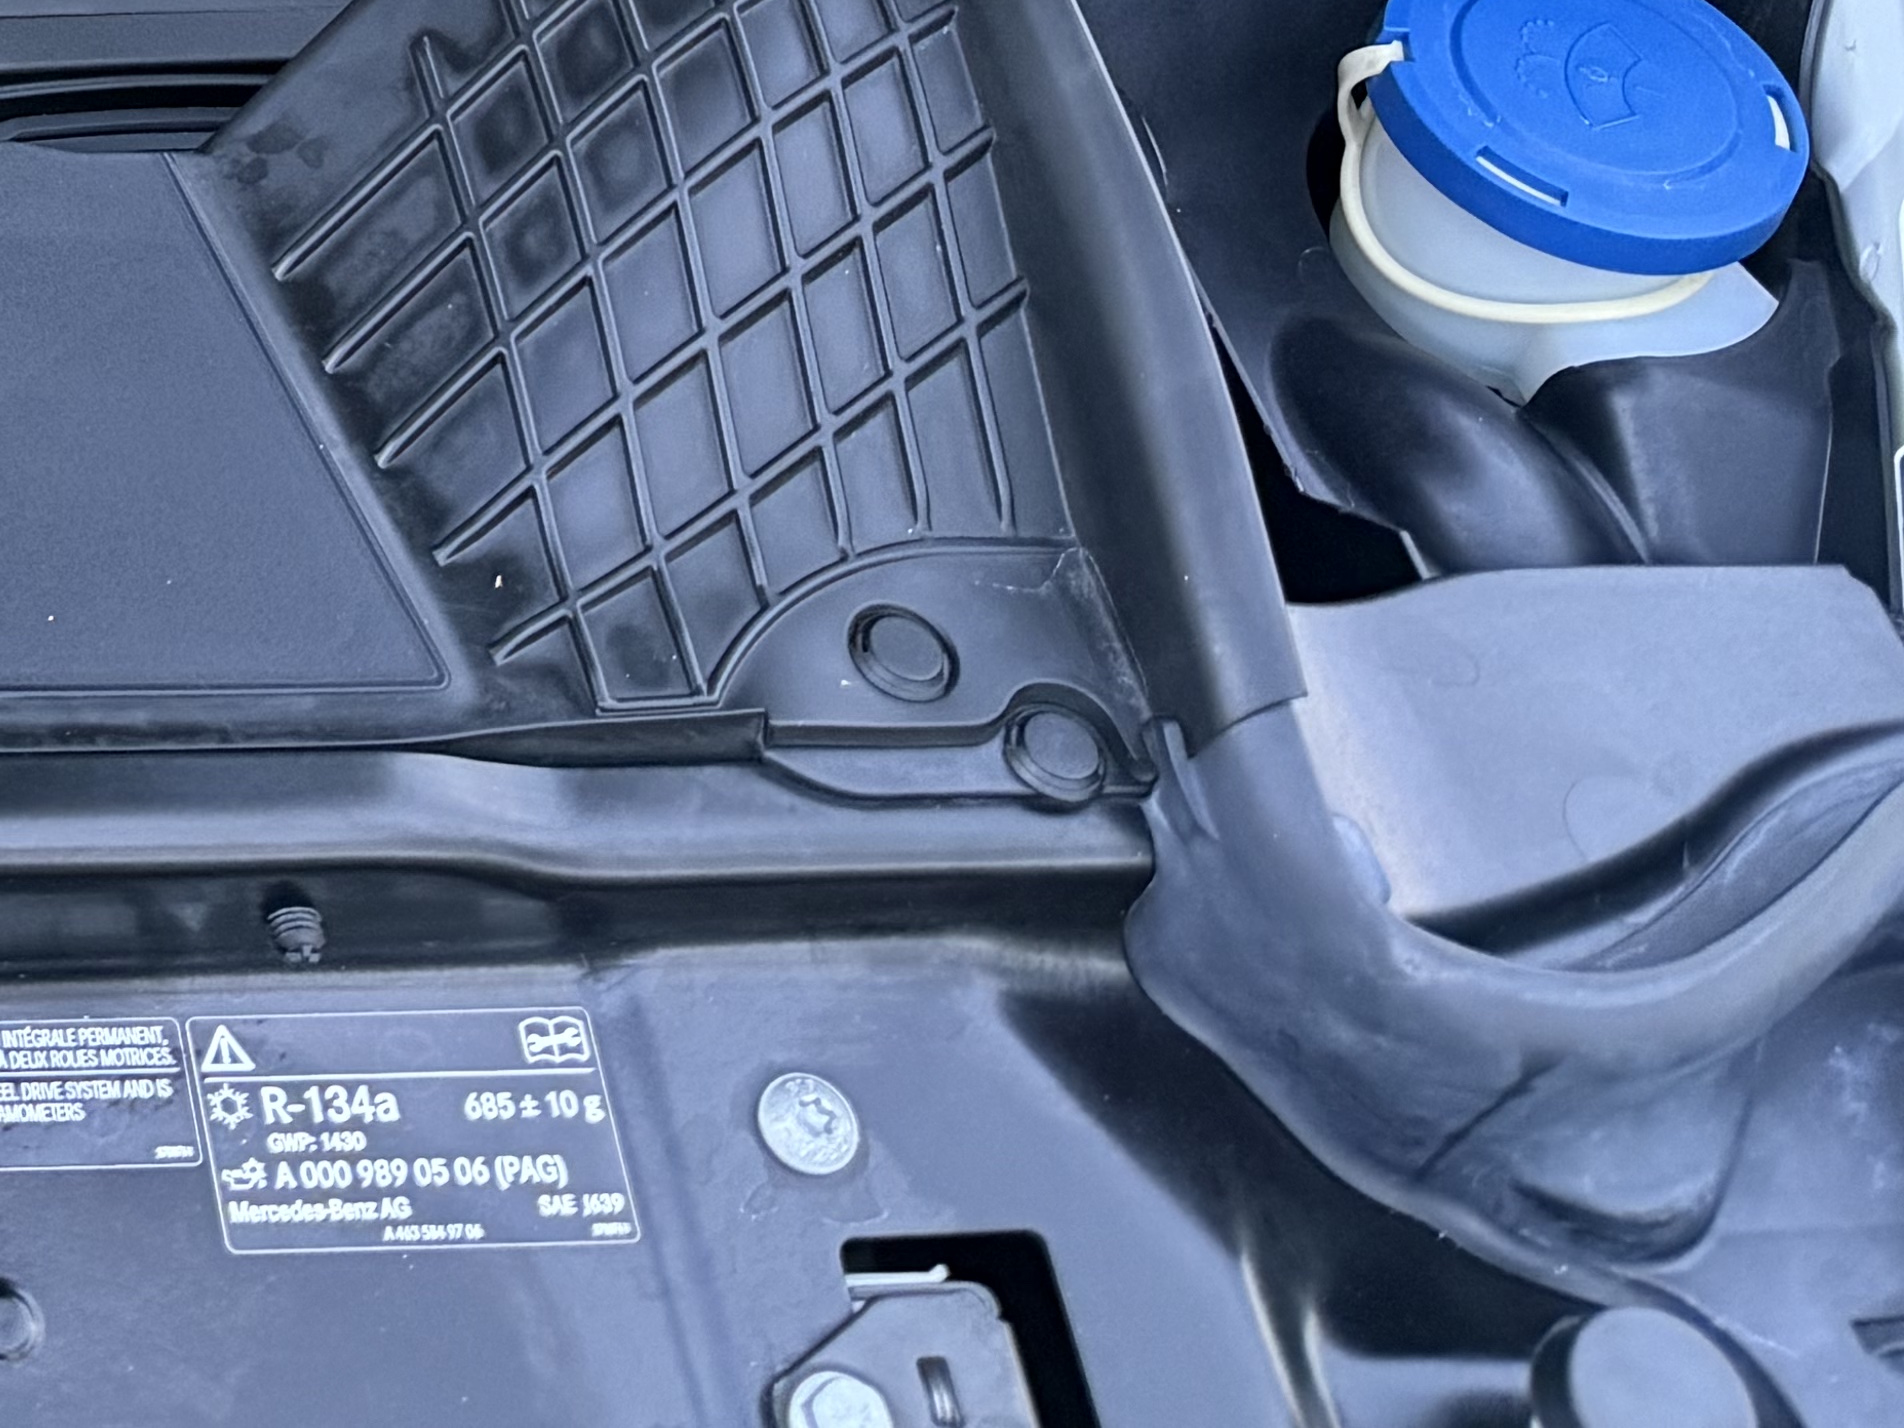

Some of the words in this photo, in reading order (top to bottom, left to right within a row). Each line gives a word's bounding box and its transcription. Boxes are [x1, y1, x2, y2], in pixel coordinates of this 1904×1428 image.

[3, 1025, 76, 1047] INTÉGRALE
[9, 1050, 49, 1068] DEUX
[50, 1048, 97, 1067] ROUES
[21, 1081, 64, 1101] DRIVE
[65, 1080, 120, 1099] SYSTEM
[122, 1079, 154, 1098] AND
[155, 1078, 174, 1097] IS
[259, 1084, 401, 1125] R-134a
[464, 1091, 516, 1121] 685
[544, 1089, 579, 1119] 10
[582, 1094, 606, 1124] g
[266, 1131, 318, 1154] GWP:
[320, 1130, 367, 1152] 1430
[274, 1160, 298, 1190] A
[299, 1159, 353, 1189] 000
[356, 1158, 408, 1188] 989
[413, 1157, 450, 1187] 05
[453, 1156, 490, 1186] 06
[494, 1154, 569, 1191] (PAG)
[228, 1198, 379, 1224] Mercedes-Benz
[380, 1195, 414, 1220] AG
[537, 1193, 579, 1217] SAE
[381, 1225, 394, 1241] A
